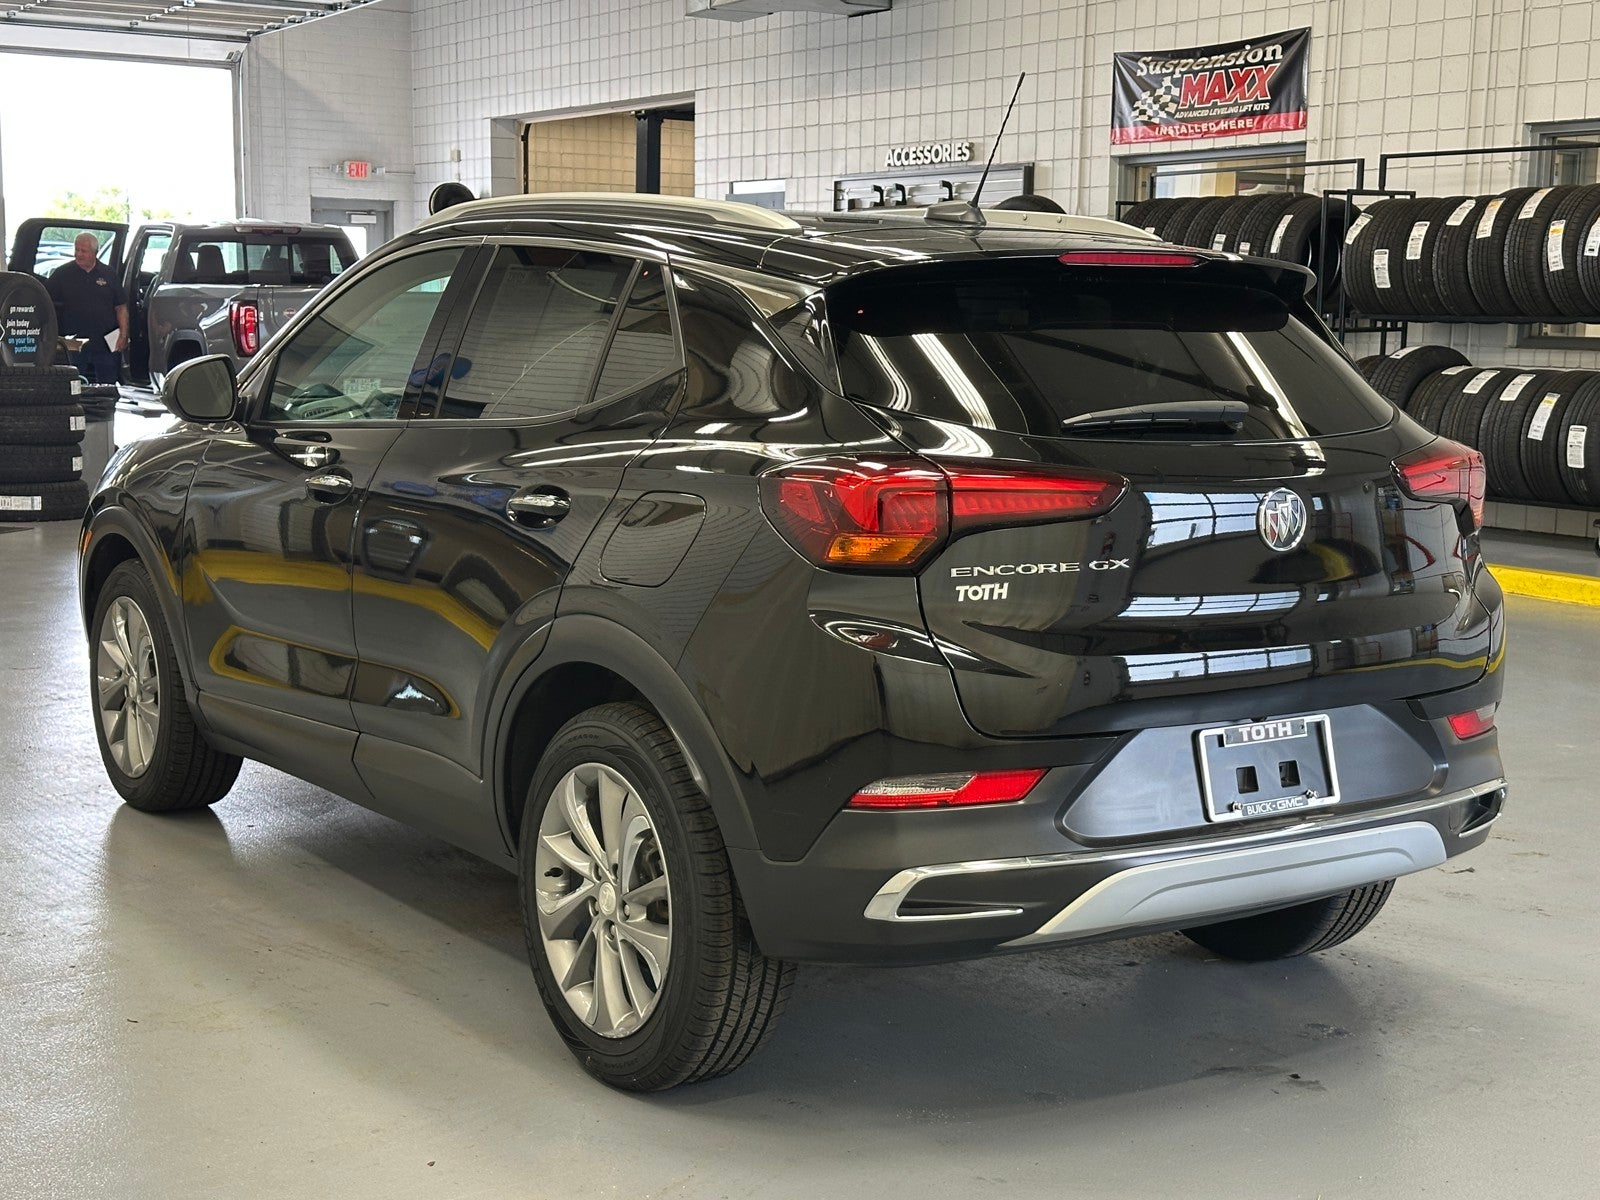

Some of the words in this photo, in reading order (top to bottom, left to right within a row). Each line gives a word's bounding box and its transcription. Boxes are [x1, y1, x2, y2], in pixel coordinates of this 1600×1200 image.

[1136, 43, 1283, 78] Suspension
[1178, 63, 1281, 109] MAXX
[1174, 109, 1209, 119] ADVANCED
[1209, 106, 1238, 116] LEVELING
[1239, 104, 1253, 113] LIFT
[1253, 102, 1270, 111] KITS
[1155, 122, 1216, 136] INSTALLED
[1220, 118, 1253, 130] HERE
[884, 142, 971, 167] ACCESSORIES
[349, 162, 368, 178] EXIT
[6, 319, 16, 328] join
[16, 319, 30, 328] today
[11, 328, 16, 336] to
[950, 562, 1081, 578] ENCORE
[1088, 558, 1130, 571] GX
[955, 582, 1010, 602] TOTH
[1238, 721, 1293, 742] TOTH
[1246, 802, 1273, 815] BUICK
[1276, 797, 1304, 809] GMC
